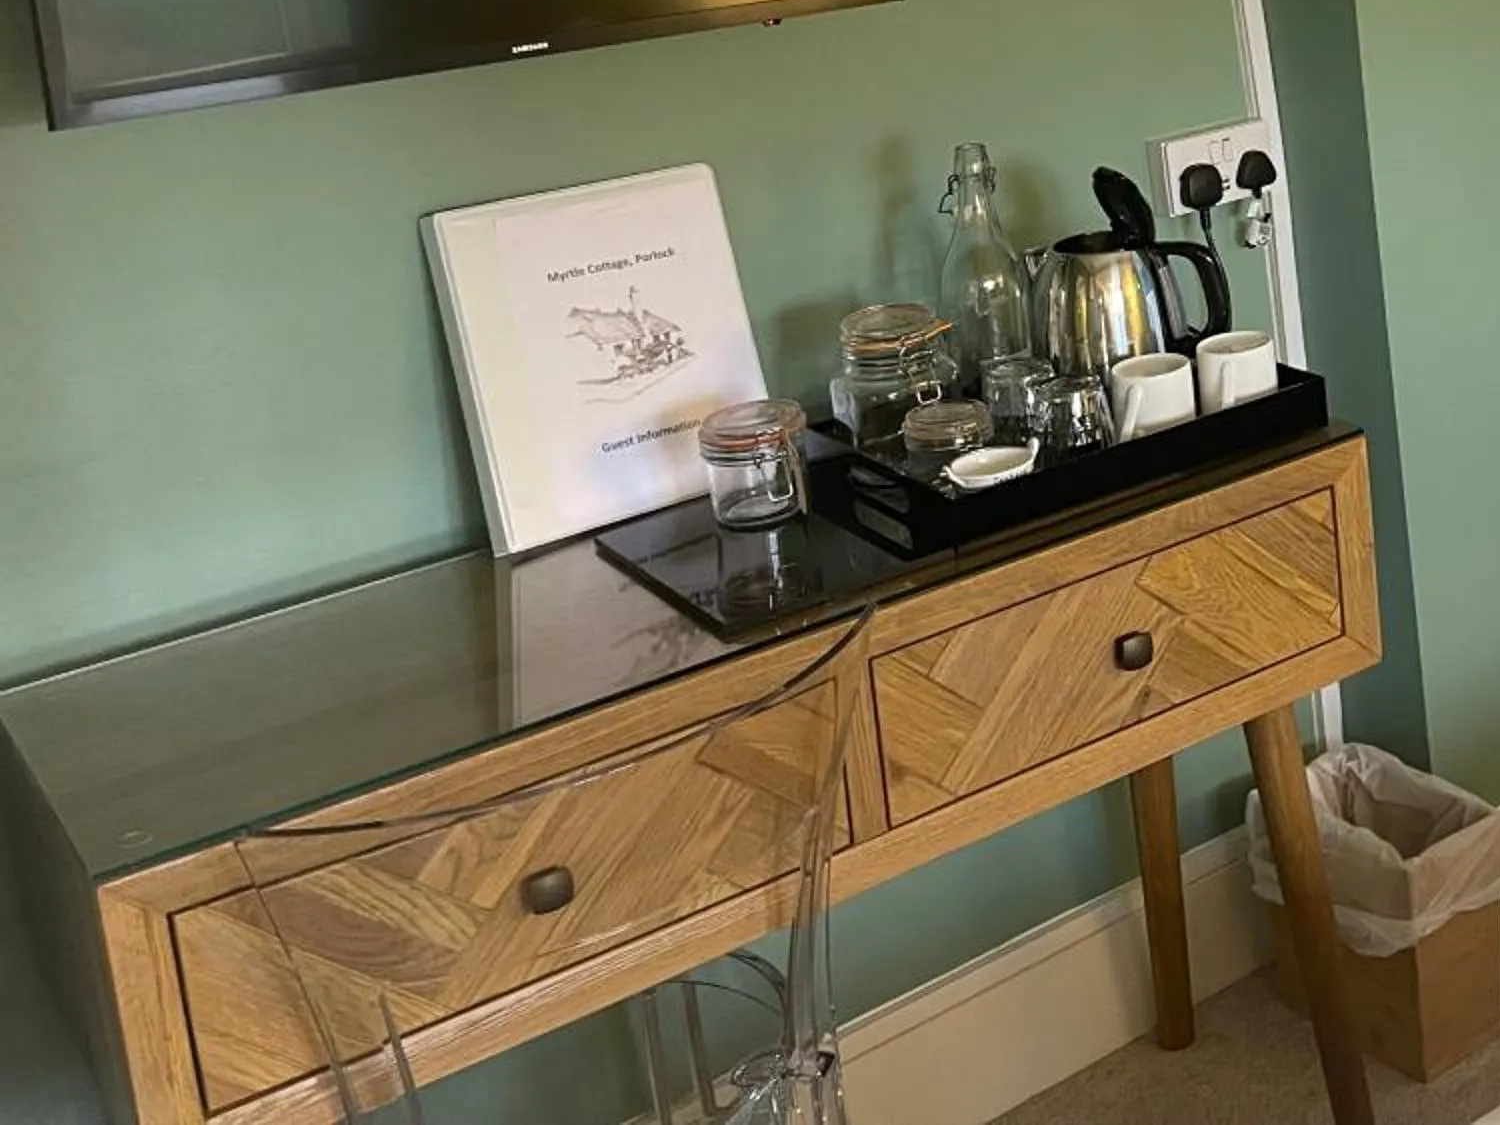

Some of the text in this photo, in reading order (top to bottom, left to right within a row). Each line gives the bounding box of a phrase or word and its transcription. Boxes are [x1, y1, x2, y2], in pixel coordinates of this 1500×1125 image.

[547, 268, 586, 283] Myrtle
[601, 419, 701, 452] Guest Information
